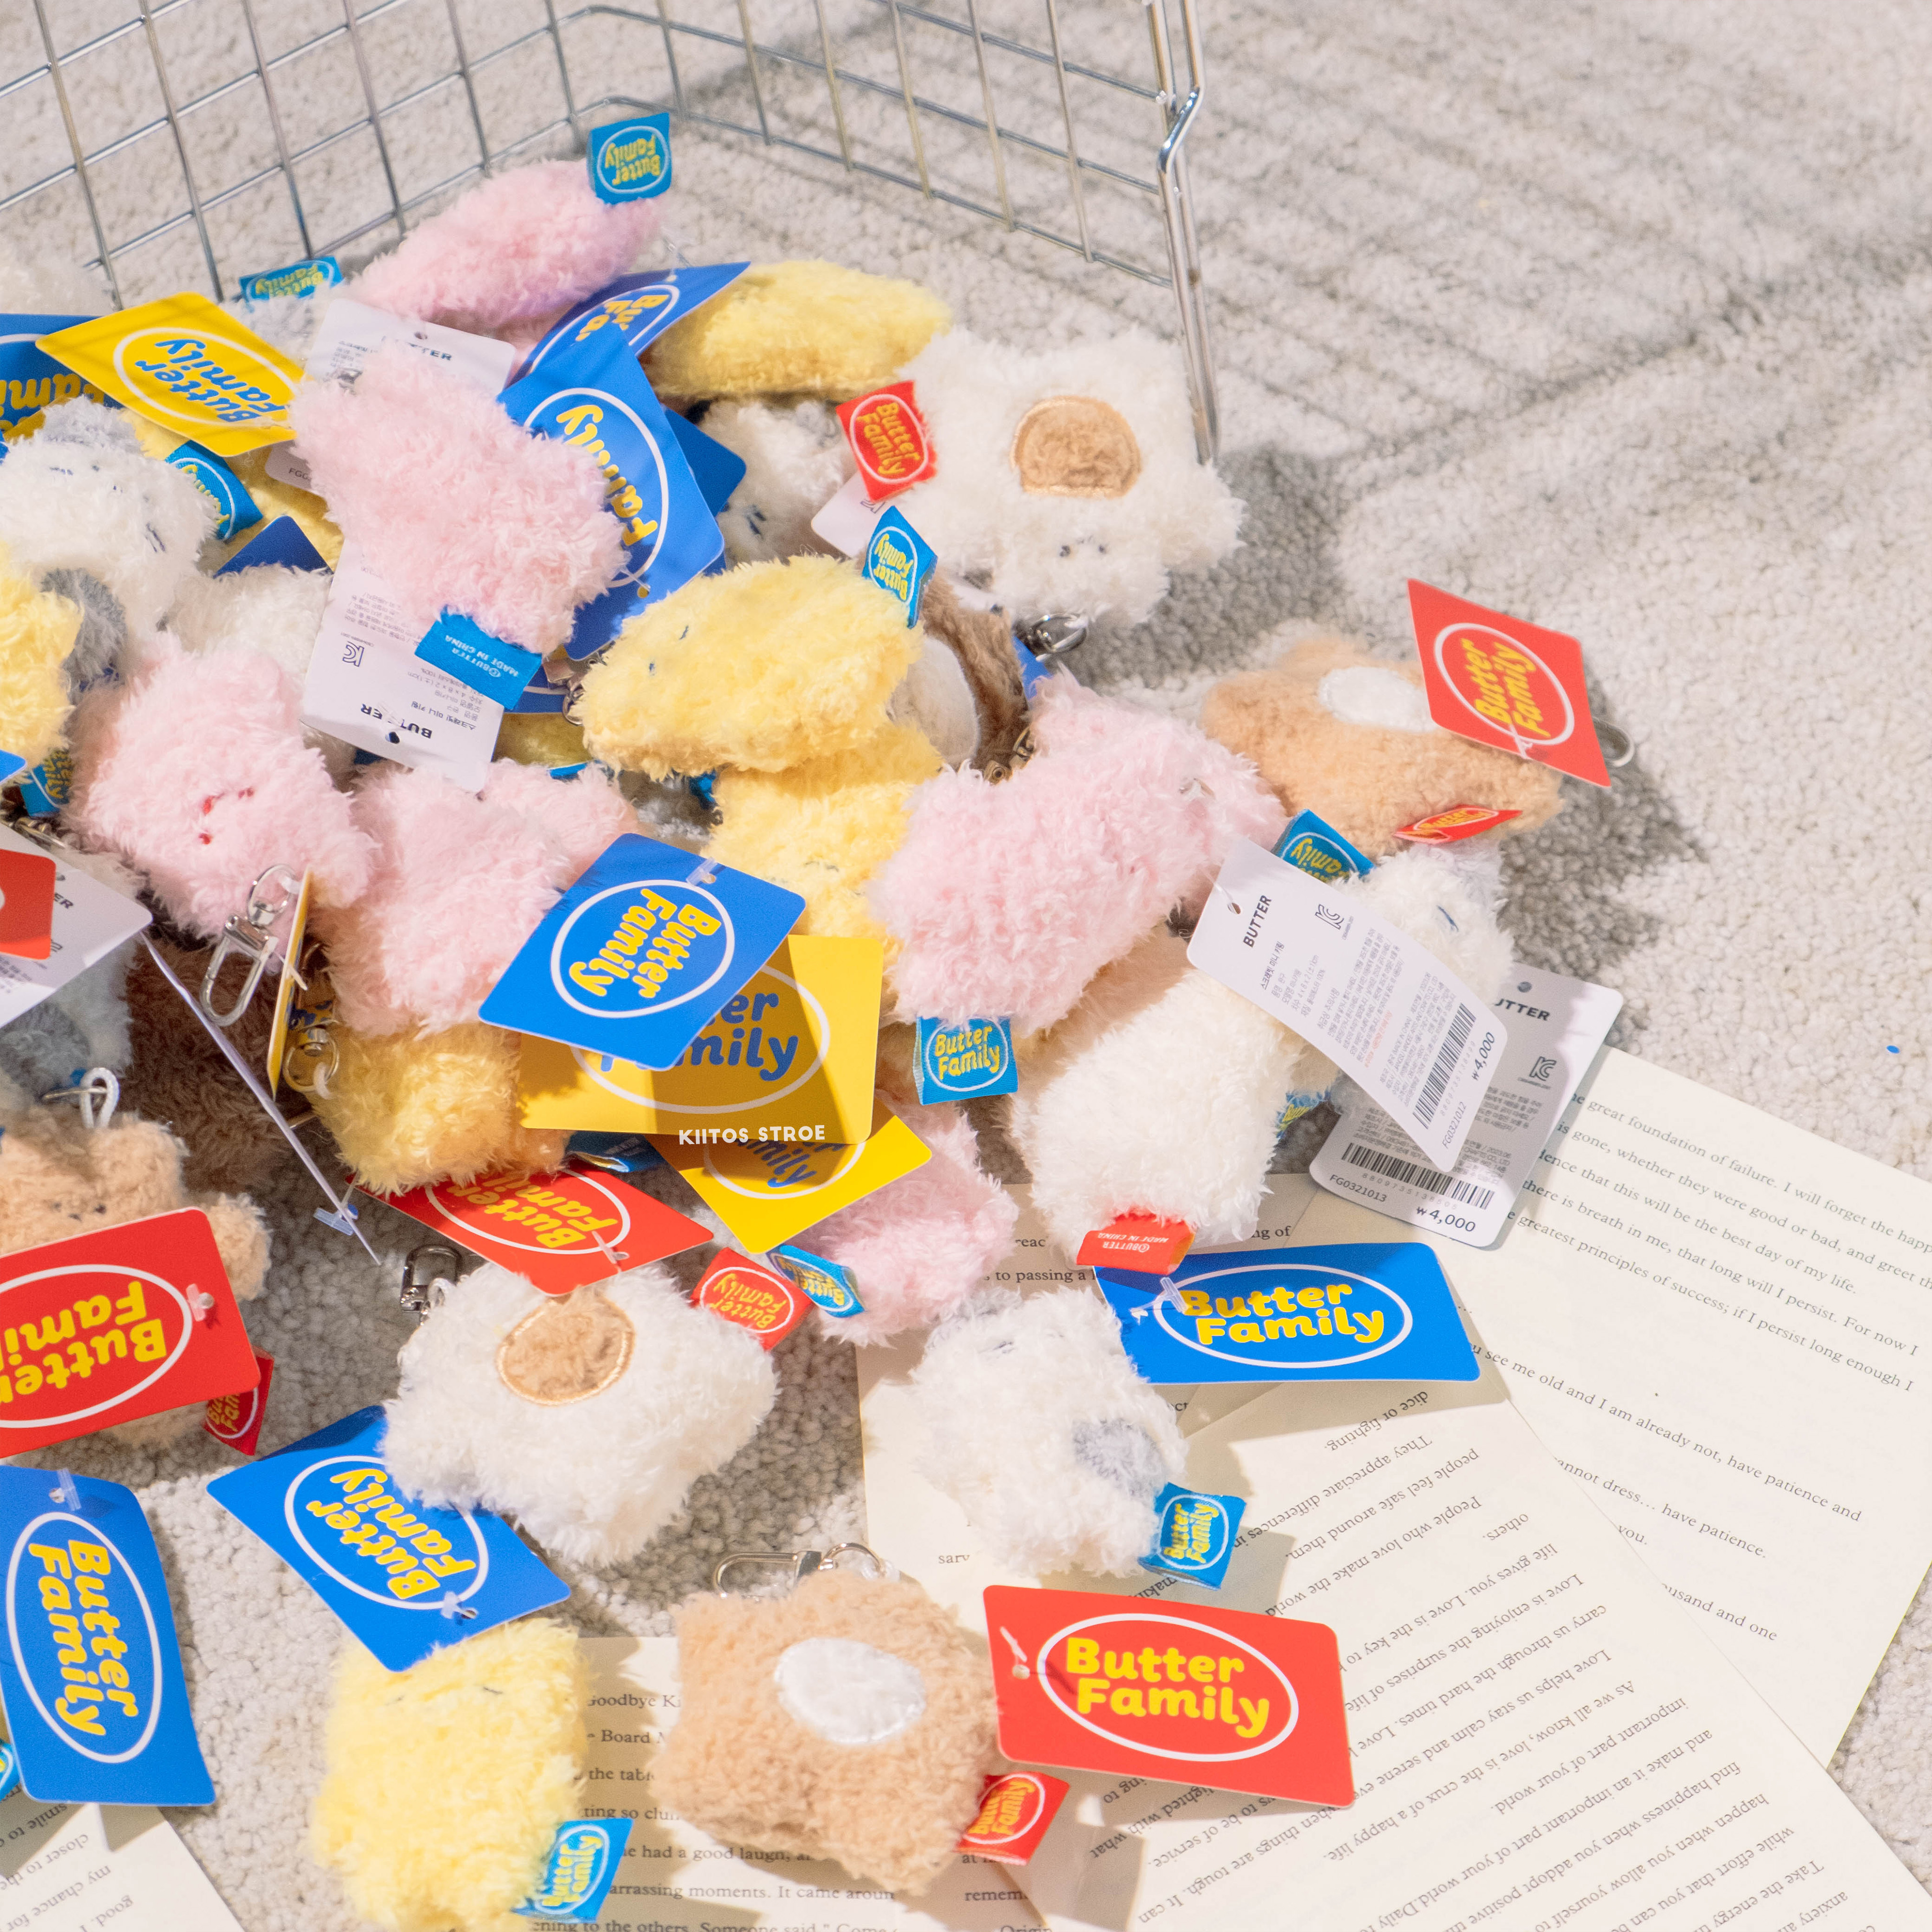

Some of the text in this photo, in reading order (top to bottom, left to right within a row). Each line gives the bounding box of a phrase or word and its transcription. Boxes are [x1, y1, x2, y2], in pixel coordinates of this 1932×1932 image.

[605, 135, 656, 169] Family
[612, 155, 661, 185] Butter
[135, 359, 262, 423] Butter
[154, 339, 292, 414] Family
[856, 412, 906, 475] Family
[876, 402, 921, 461] Butter
[874, 533, 914, 579] Family
[445, 635, 519, 677] MADE IN CHINA
[1460, 637, 1513, 725] Butter
[1491, 641, 1551, 737] Family
[411, 700, 426, 712] 키링
[428, 708, 444, 718] 미니
[570, 888, 677, 997] Family
[1241, 894, 1272, 947] BUTTER
[633, 904, 721, 998] Butter
[1268, 953, 1279, 966] 미니
[1273, 941, 1285, 954] 키링
[935, 1026, 993, 1056] Butter
[938, 1045, 1000, 1080] Family
[1441, 1101, 1467, 1149] FG0321012
[1329, 1173, 1387, 1202] FG0321013
[1587, 1101, 1894, 1236] great foundation of failure. I will forget the
[1415, 1206, 1476, 1233] ₩4,000
[1572, 1131, 1915, 1282] gone, whether they were good or bad, and greet
[1097, 1232, 1125, 1240] CHINA
[1270, 1225, 1291, 1239] of
[713, 1273, 786, 1314] Family
[996, 1269, 1086, 1285] to passing a
[1181, 1284, 1352, 1317] Butter
[709, 1298, 776, 1328] Butter
[1196, 1308, 1384, 1345] Family
[1517, 1213, 1914, 1392] greatest principles of success; if I persist long enough I
[329, 1469, 476, 1578] Family
[1285, 1448, 1480, 1559] people feel safe around them.
[1482, 1514, 1529, 1541] others.
[1603, 1479, 1765, 1558] dress... have patience.
[306, 1499, 441, 1600] Butter
[1164, 1503, 1190, 1559] Butter
[1186, 1503, 1219, 1563] Family
[1264, 1495, 1483, 1616] People who love make the world
[28, 1543, 106, 1737] Family
[67, 1539, 139, 1719] Butter
[1749, 1624, 1777, 1641] one
[1067, 1636, 1245, 1684] Butter
[1077, 1677, 1269, 1739] Family
[602, 1730, 650, 1743] Board
[1491, 1698, 1686, 1815] important part of your world.
[589, 1767, 614, 1780] the
[1323, 1680, 1634, 1861] As we all know, love is the crux of a happy life.
[622, 1808, 639, 1819] so
[26, 1834, 89, 1874] closer to
[542, 1843, 573, 1907] Butter
[561, 1835, 602, 1902] Family
[642, 1846, 672, 1859] had
[679, 1849, 687, 1858] a
[693, 1846, 733, 1862] good
[7, 1865, 111, 1931] my chance for
[689, 1885, 840, 1900] moments. It came
